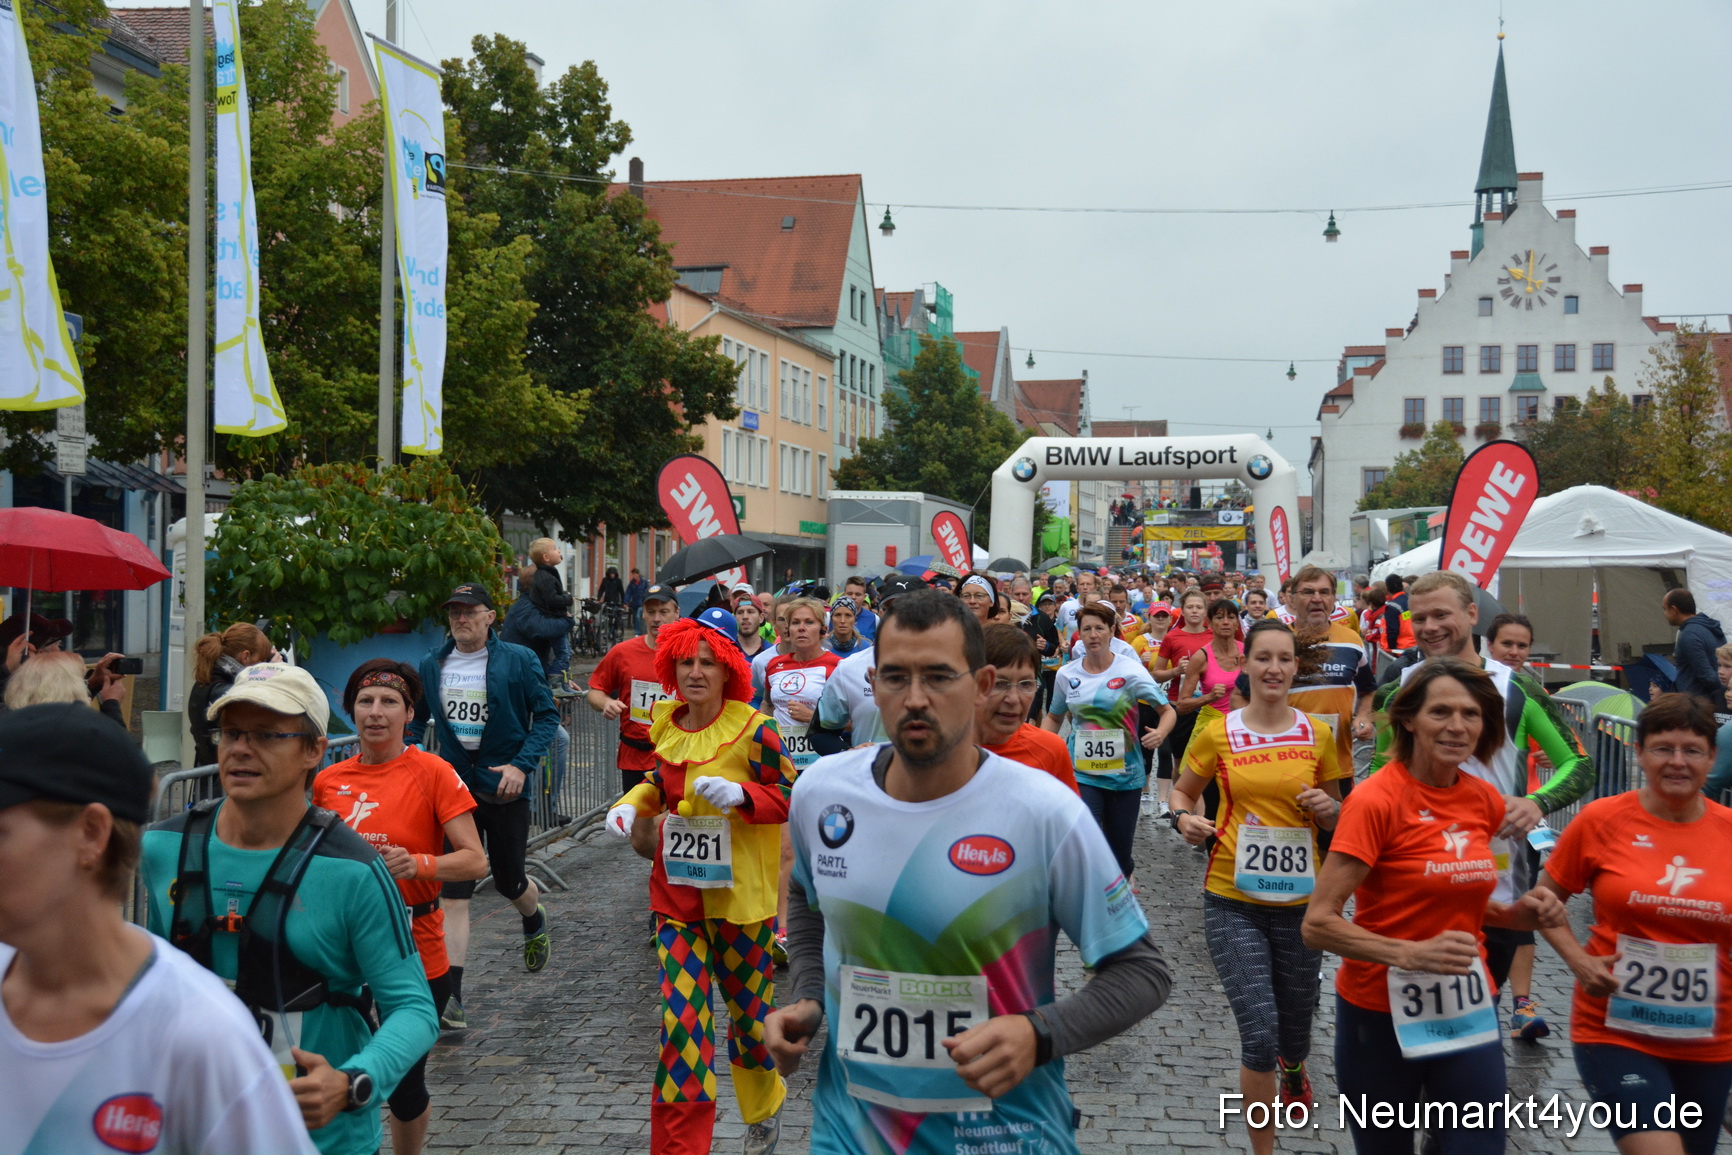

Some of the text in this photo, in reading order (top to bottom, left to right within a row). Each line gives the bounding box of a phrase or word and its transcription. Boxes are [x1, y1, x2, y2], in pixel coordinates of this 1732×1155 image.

[1046, 446, 1237, 469] BMW Laufsport
[1448, 460, 1526, 588] REWE
[1183, 529, 1207, 538] ZIEL
[447, 700, 490, 723] 2893
[1084, 740, 1115, 758] 345
[1233, 748, 1317, 767] MAX BÖGL
[1091, 761, 1109, 769] Petra
[689, 818, 723, 828] BOCK
[1275, 829, 1307, 840] BOCK
[669, 831, 722, 861] 2261
[957, 843, 1007, 866] Hervis
[818, 854, 848, 870] PARTL
[1245, 844, 1308, 873] 2683
[1423, 858, 1493, 877] funrunners
[817, 866, 847, 879] Neumarkt
[1258, 878, 1295, 892] Sandra
[1627, 890, 1722, 913] funrunners
[1664, 947, 1708, 958] BOCK
[851, 982, 891, 996] NeuerMarkt
[900, 979, 973, 997] BOCK
[1623, 960, 1709, 1003] 2295
[1401, 970, 1484, 1018] 3110
[1630, 1005, 1697, 1026] Michaela
[854, 1003, 972, 1060] 2015
[954, 1121, 1035, 1138] Neumarkter
[955, 1138, 1024, 1155] Stadtlauf
